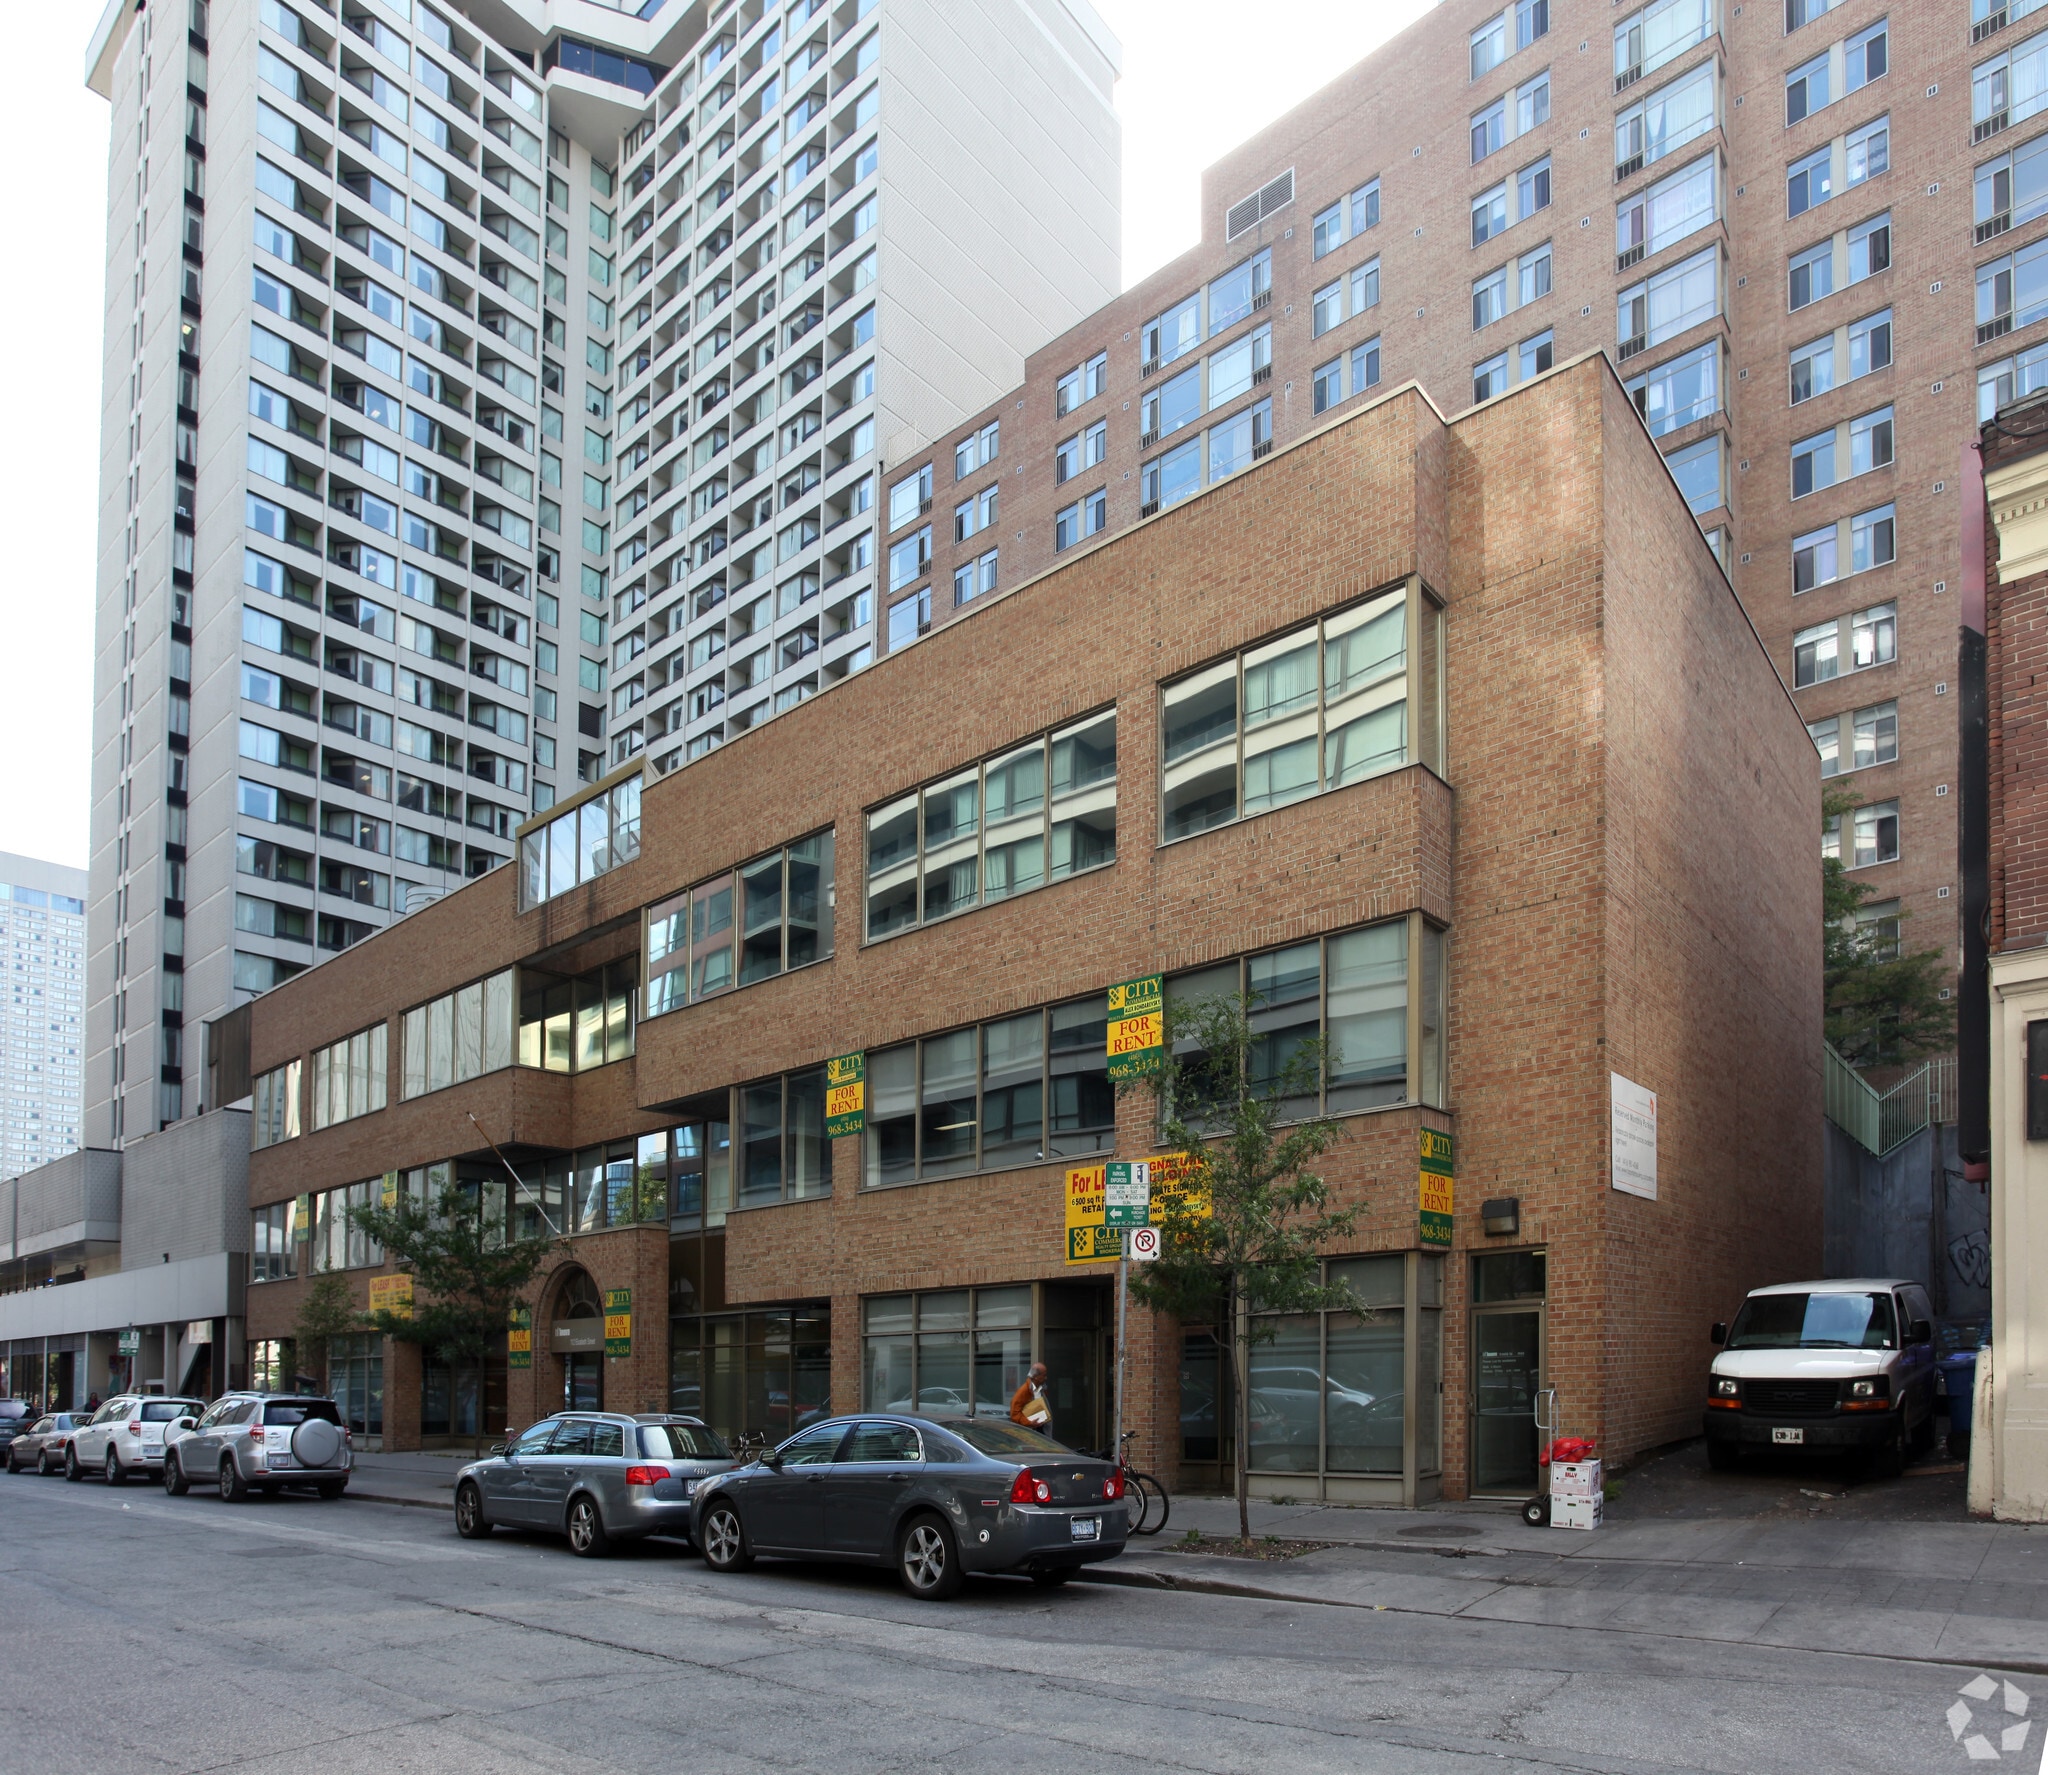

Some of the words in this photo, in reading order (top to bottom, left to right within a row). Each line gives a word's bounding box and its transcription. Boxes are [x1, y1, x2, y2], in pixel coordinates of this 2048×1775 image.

[1125, 976, 1162, 1000] CITY
[1119, 1016, 1150, 1037] FOR
[1113, 1030, 1157, 1054] RENT
[839, 1053, 864, 1071] CITY
[835, 1085, 856, 1101] FOR
[831, 1097, 860, 1115] RENT
[827, 1119, 863, 1137] 968-3434
[1431, 1134, 1452, 1156] CITY
[1072, 1172, 1091, 1195] For
[1427, 1174, 1447, 1194] FOR
[1071, 1196, 1086, 1206] 6500
[1086, 1196, 1095, 1206] sq
[1095, 1194, 1101, 1203] ft
[1082, 1204, 1105, 1214] RETAI
[1423, 1192, 1450, 1213] RENT
[1095, 1227, 1120, 1240] CIT
[1420, 1223, 1451, 1241] 968-3434
[613, 1291, 630, 1302] CITY
[610, 1315, 625, 1326] FOR
[513, 1331, 526, 1341] FOR
[607, 1326, 628, 1338] RENT
[511, 1340, 528, 1351] RENT
